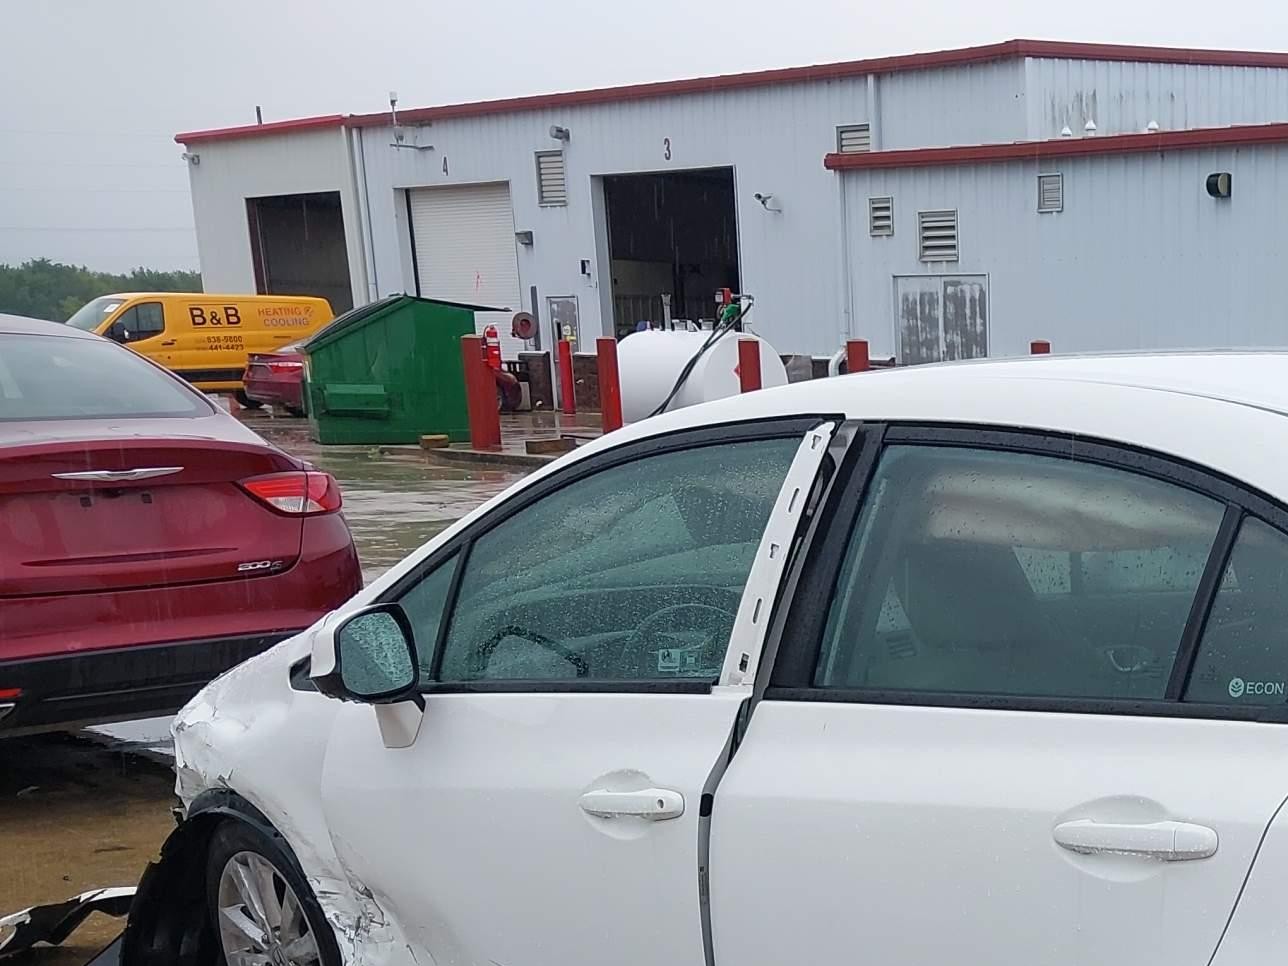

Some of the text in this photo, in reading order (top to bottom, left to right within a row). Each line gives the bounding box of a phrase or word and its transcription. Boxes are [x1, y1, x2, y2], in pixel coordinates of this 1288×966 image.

[663, 137, 672, 161] 3
[442, 156, 449, 177] 4
[257, 306, 302, 317] HEATING
[263, 317, 310, 327] COOLING
[1246, 682, 1285, 695] ECON
